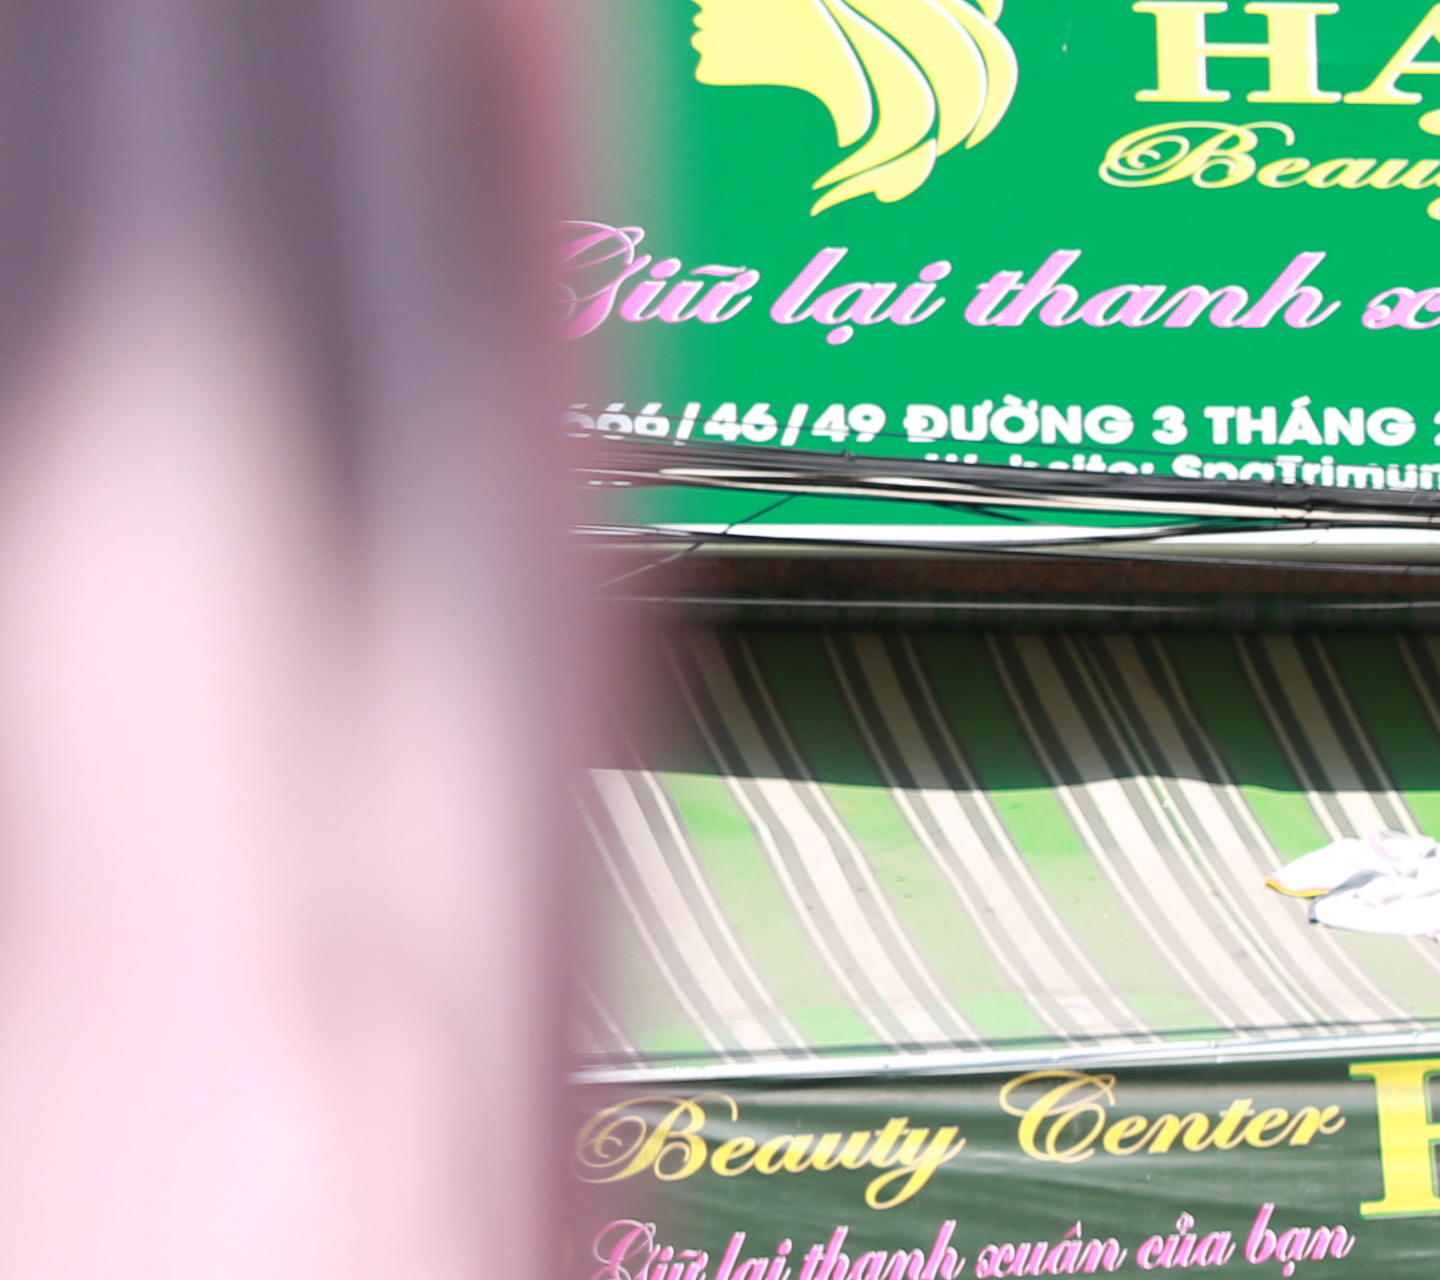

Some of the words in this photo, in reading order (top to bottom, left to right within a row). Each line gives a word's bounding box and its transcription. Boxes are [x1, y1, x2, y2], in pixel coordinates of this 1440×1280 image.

[771, 247, 947, 345] lại
[964, 248, 1340, 328] thanh
[904, 393, 1134, 445] ĐƯỜNG
[1152, 405, 1188, 445] 3
[1204, 396, 1417, 446] THÁNG
[573, 1091, 966, 1210] Beauty
[1000, 1069, 1346, 1163] Center
[1137, 1212, 1238, 1271] của
[1246, 1203, 1357, 1278] bạn
